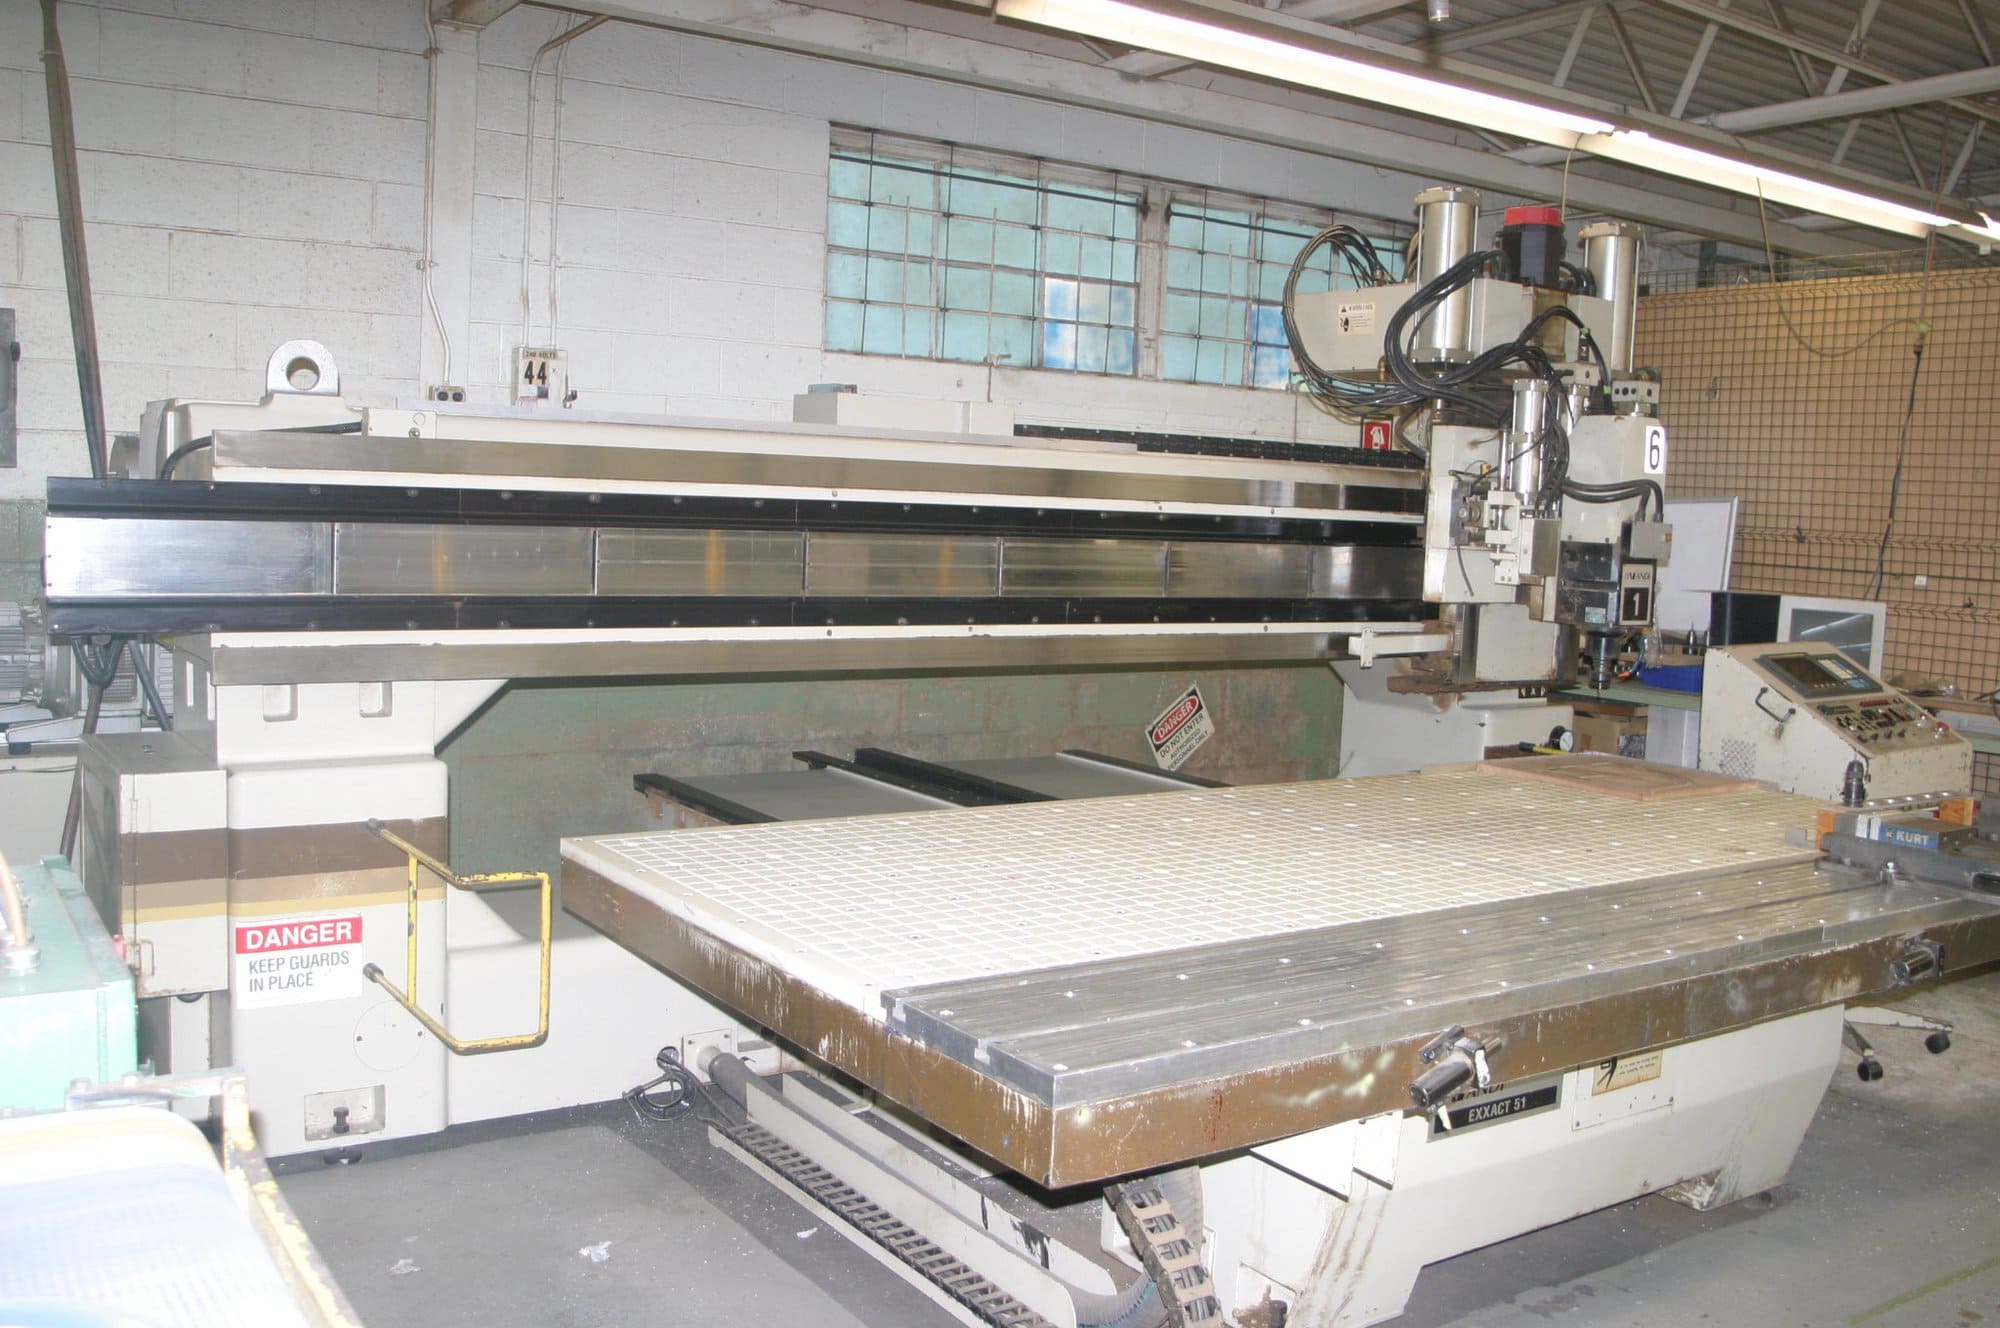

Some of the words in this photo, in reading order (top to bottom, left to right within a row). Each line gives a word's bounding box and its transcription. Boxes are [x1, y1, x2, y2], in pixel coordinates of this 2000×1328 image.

[524, 360, 547, 385] 44
[1649, 429, 1664, 470] 6
[1633, 592, 1640, 616] 1
[1158, 700, 1193, 738] DANGER
[1160, 744, 1170, 758] DO
[1170, 730, 1185, 748] NOT
[1183, 712, 1205, 735] ENTER
[1896, 830, 1929, 846] KURT
[245, 920, 353, 950] DANGER
[248, 956, 286, 975] KEEP
[289, 950, 350, 970] GUARDS
[248, 977, 264, 993] IN
[268, 971, 314, 991] PLACE
[1468, 1100, 1512, 1122] EXXACT
[1513, 1095, 1527, 1111] 51
